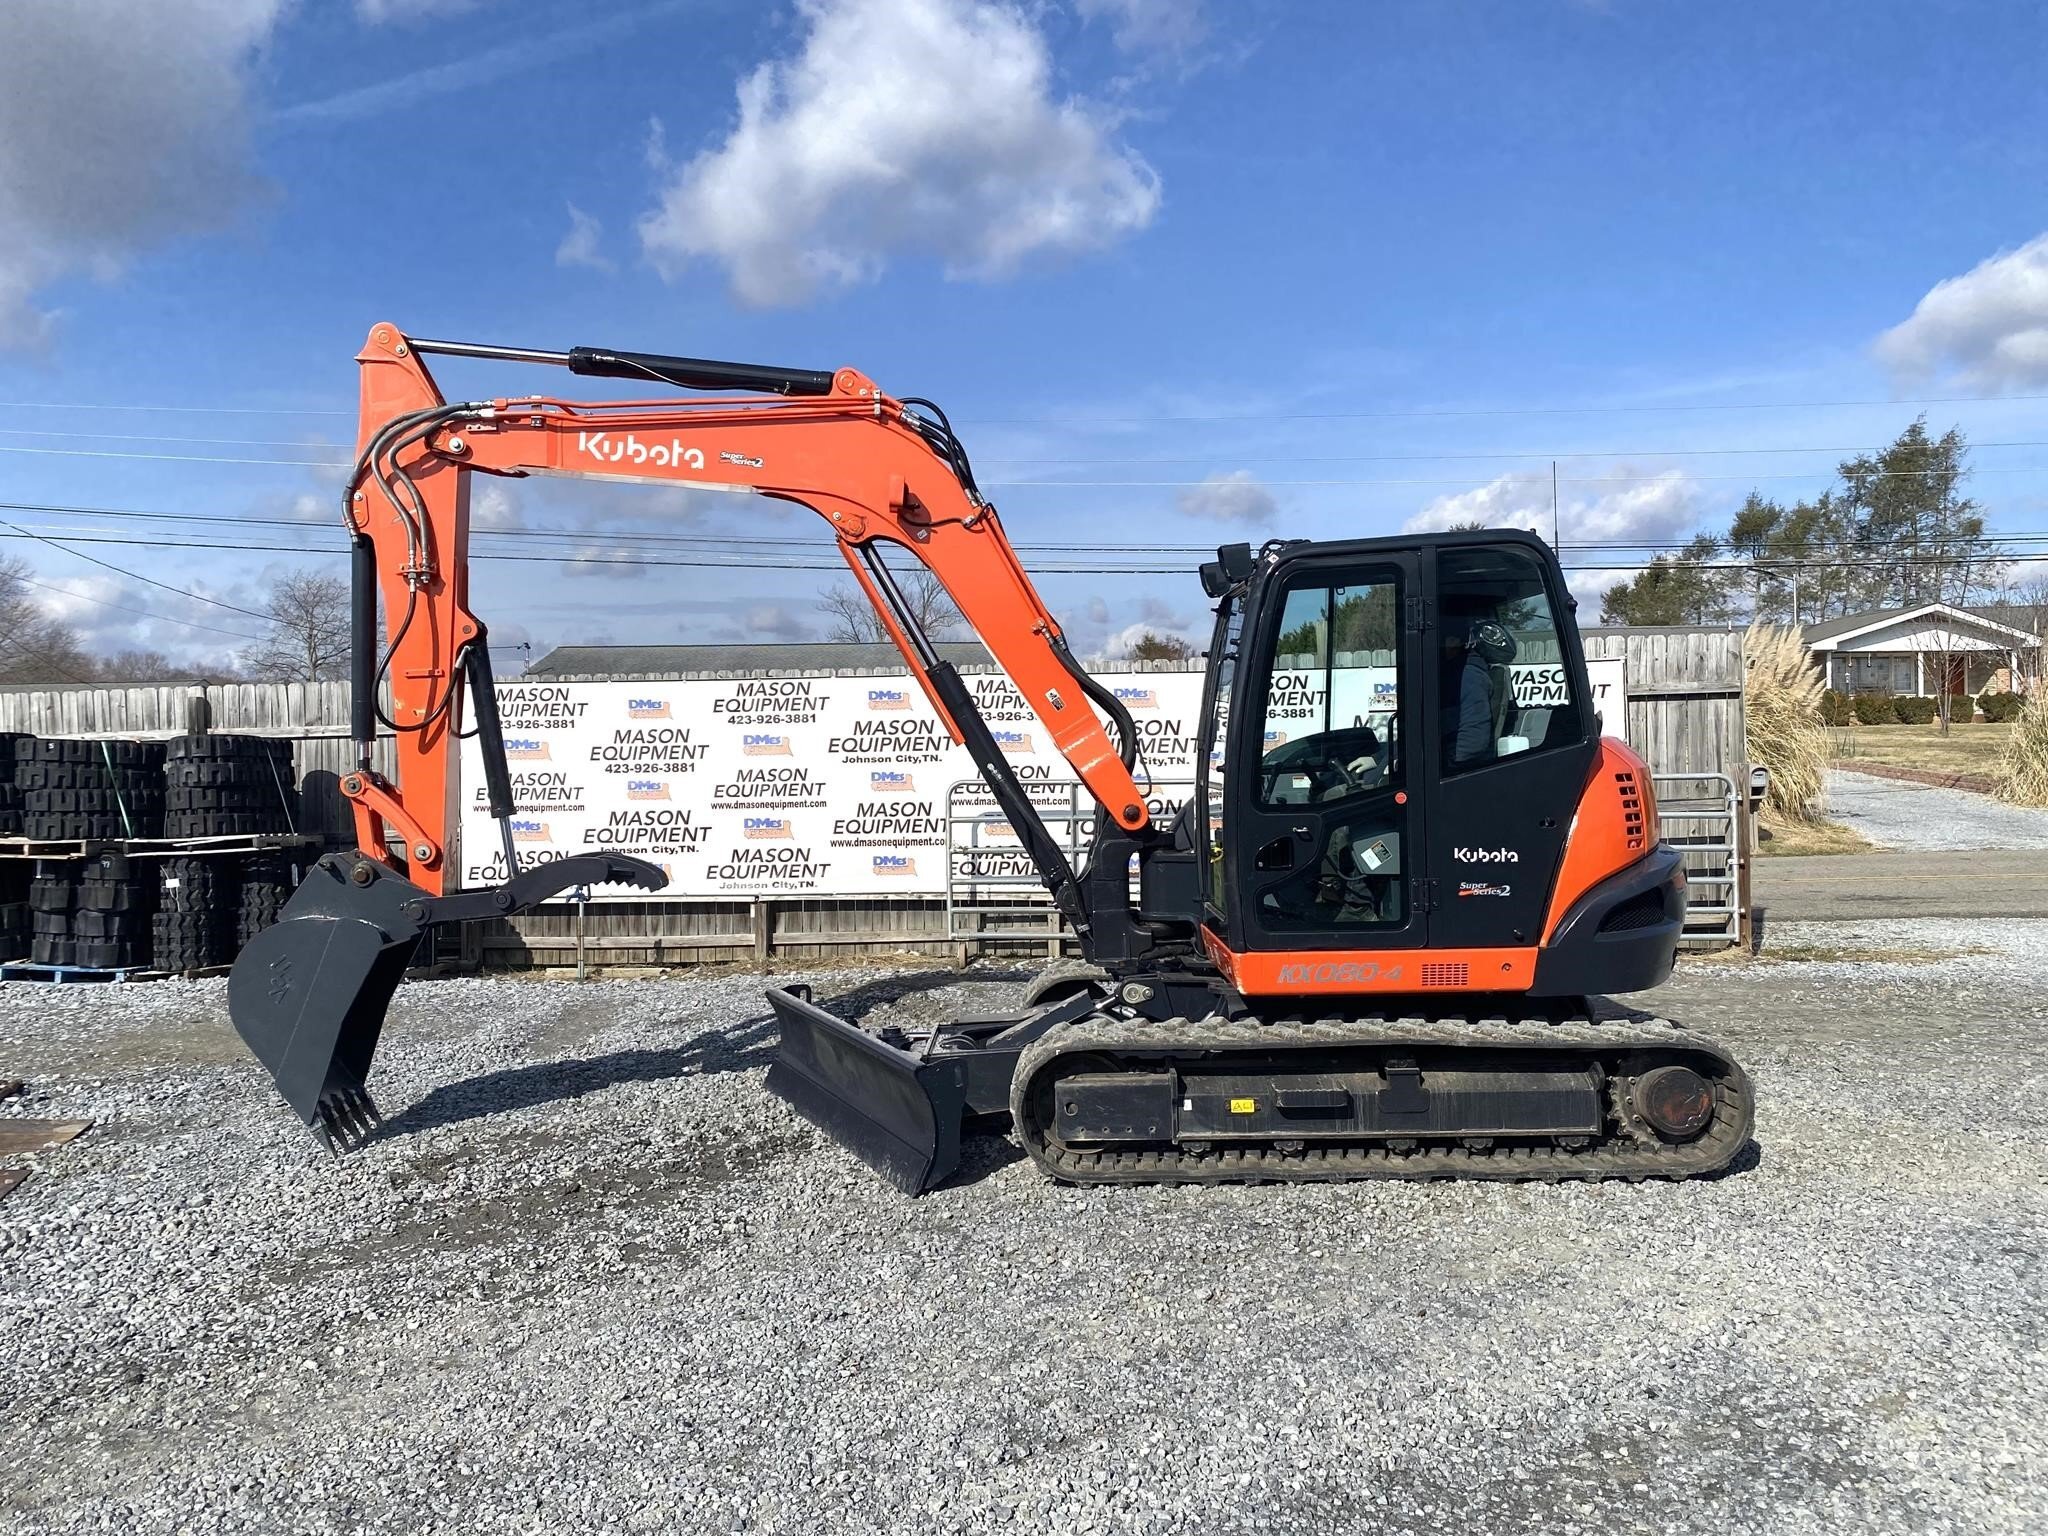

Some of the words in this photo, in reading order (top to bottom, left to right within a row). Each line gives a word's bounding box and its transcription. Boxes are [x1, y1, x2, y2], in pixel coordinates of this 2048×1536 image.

[578, 431, 704, 469] Kubota
[1511, 669, 1566, 685] MASO
[497, 687, 570, 702] MASON
[736, 681, 811, 697] MASON
[976, 680, 1017, 694] MAS
[497, 703, 589, 717] UIPMENT
[713, 696, 830, 713] EQUIPMENT
[971, 695, 1029, 710] QUIPM
[728, 714, 816, 725] 423-926-3881
[1268, 708, 1314, 719] 6-3881
[501, 719, 575, 729] 3-926-3881
[853, 719, 935, 736] MASON
[1104, 720, 1181, 736] MSON
[614, 728, 690, 744] MASON
[828, 736, 952, 753] EQUIPMENT
[590, 744, 710, 761] EQUIPMENT
[842, 755, 892, 763] Johnson
[605, 763, 695, 774] 423-926-3881
[736, 768, 808, 783] MASON
[508, 772, 567, 786] ASON
[476, 786, 585, 800] EIPMENT
[714, 782, 826, 798] EQUIPMENT
[473, 803, 585, 814] wwwonequipment.com
[711, 800, 827, 811] www.dmasonequipment.com
[857, 801, 933, 817] MASON
[951, 797, 1071, 806] www.dmasment.com
[609, 809, 691, 826] MASON
[833, 818, 947, 834] EQUIPMENT
[583, 827, 712, 843] EQUIPMENT
[830, 836, 945, 848] www.dmasonequipment.co
[731, 847, 811, 863] MASON
[1454, 847, 1519, 863] Kubota
[706, 864, 831, 879] EQUIPMENT
[1459, 882, 1488, 891] Super
[1277, 962, 1403, 984] KX080-4
